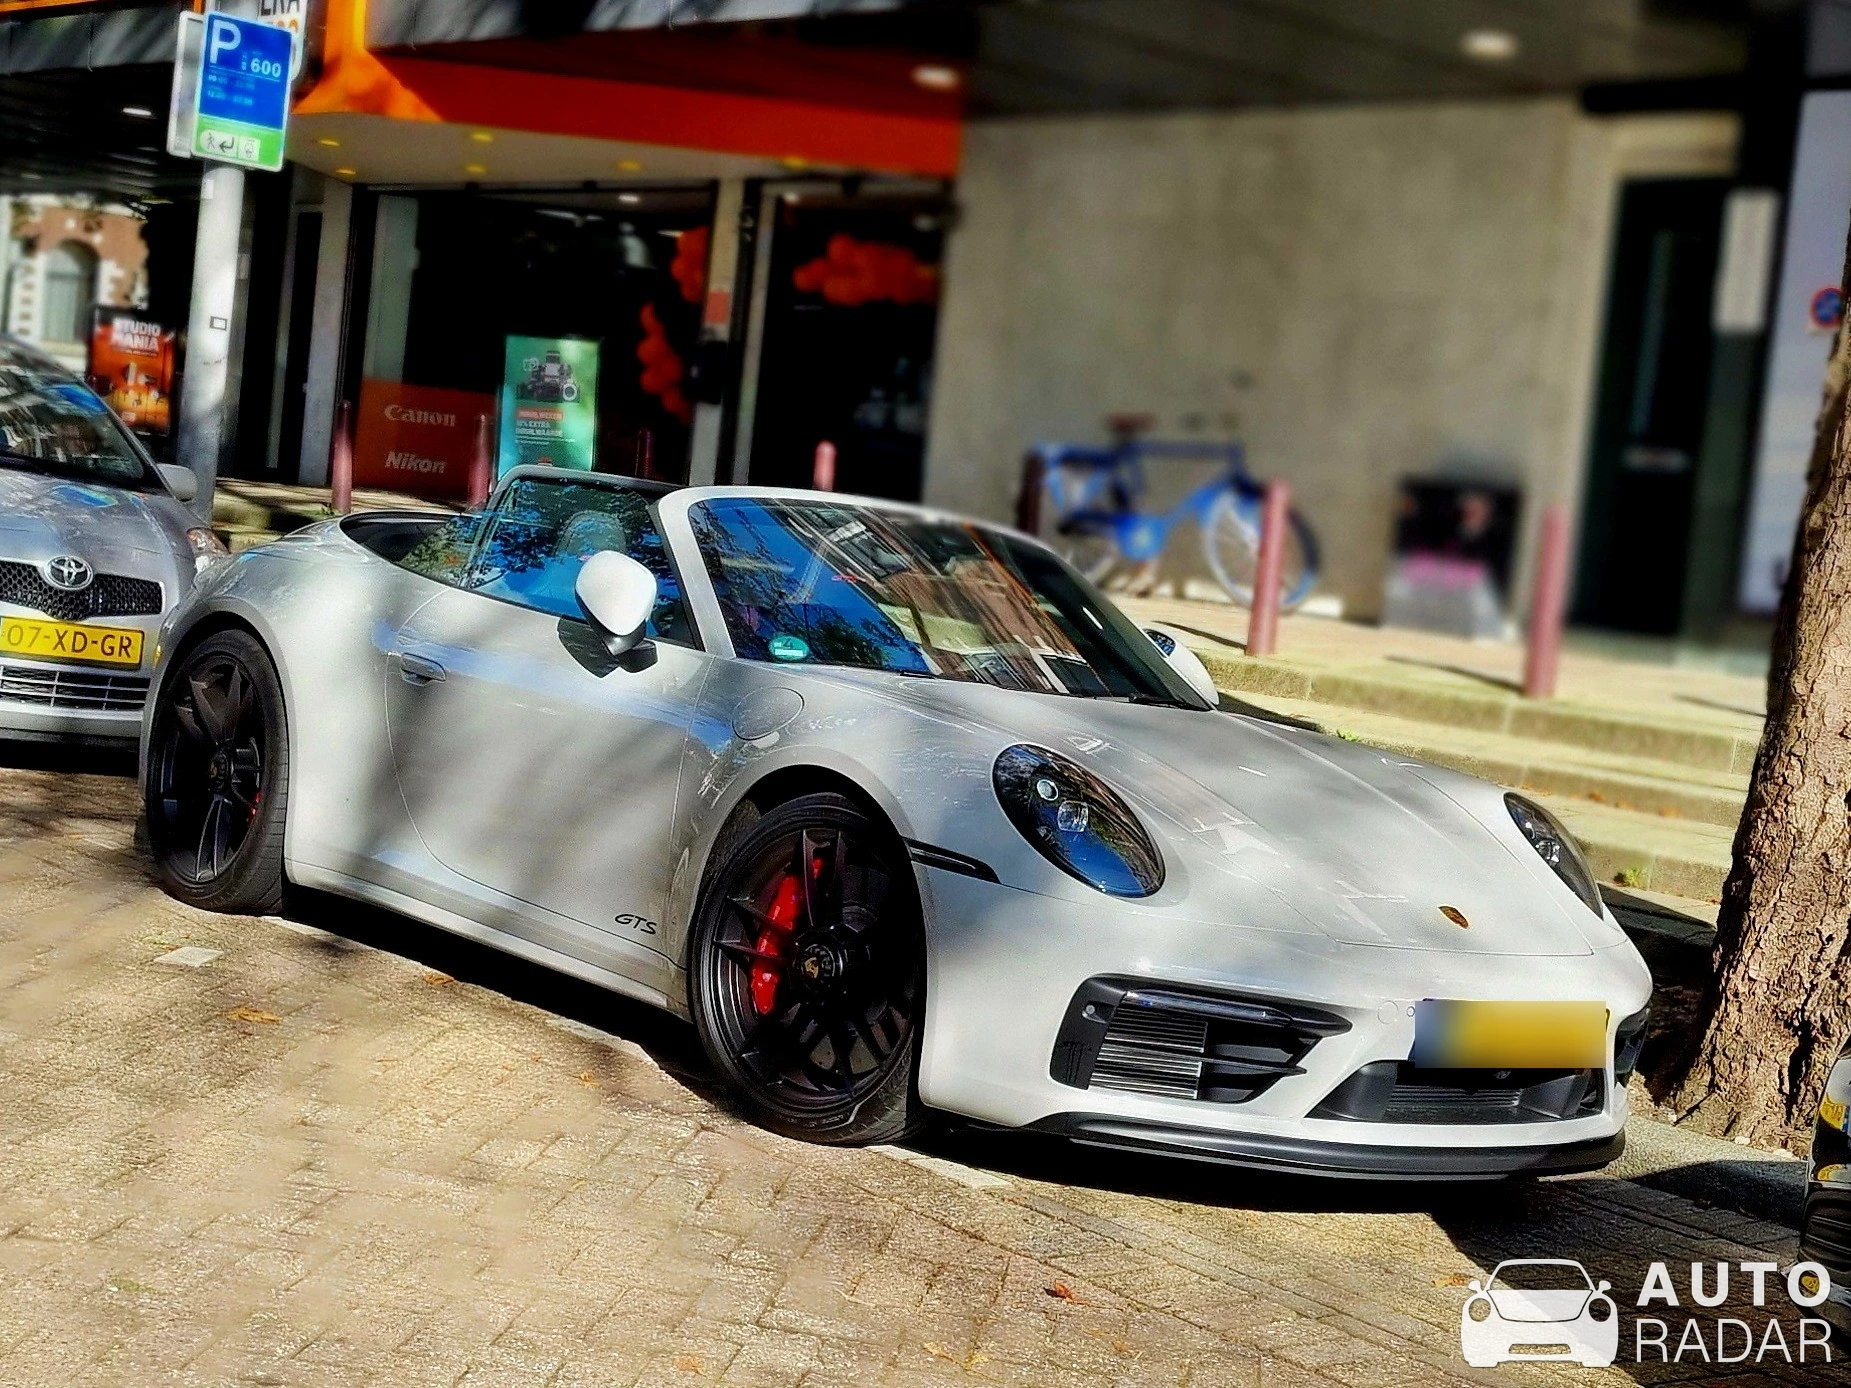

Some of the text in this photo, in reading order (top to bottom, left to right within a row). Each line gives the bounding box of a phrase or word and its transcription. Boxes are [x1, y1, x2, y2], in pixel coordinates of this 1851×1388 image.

[209, 19, 242, 64] P
[250, 57, 282, 78] 600
[384, 404, 456, 428] Canon
[385, 450, 447, 474] Nikon
[7, 623, 134, 659] 07-XD-GR
[614, 913, 658, 936] GTS
